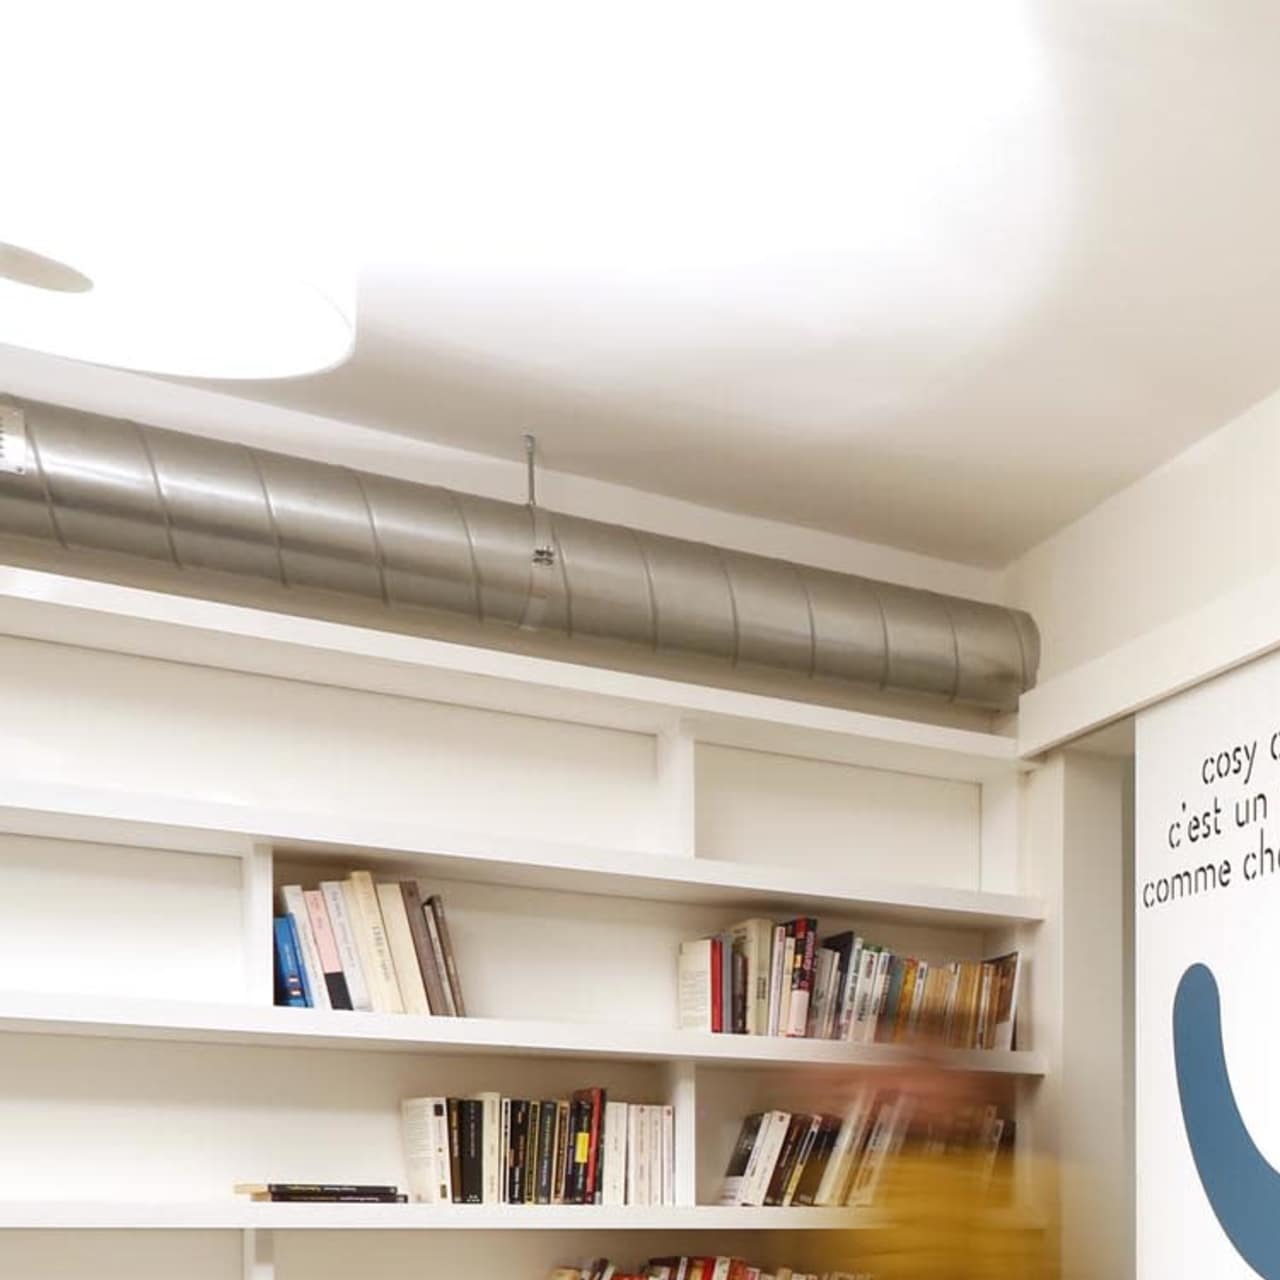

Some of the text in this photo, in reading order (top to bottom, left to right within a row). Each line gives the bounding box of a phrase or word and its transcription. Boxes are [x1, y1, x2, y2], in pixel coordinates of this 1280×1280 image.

[1201, 740, 1257, 785] cosy
[1168, 796, 1222, 849] c'est
[1234, 792, 1268, 828] un
[1143, 859, 1232, 908] comme
